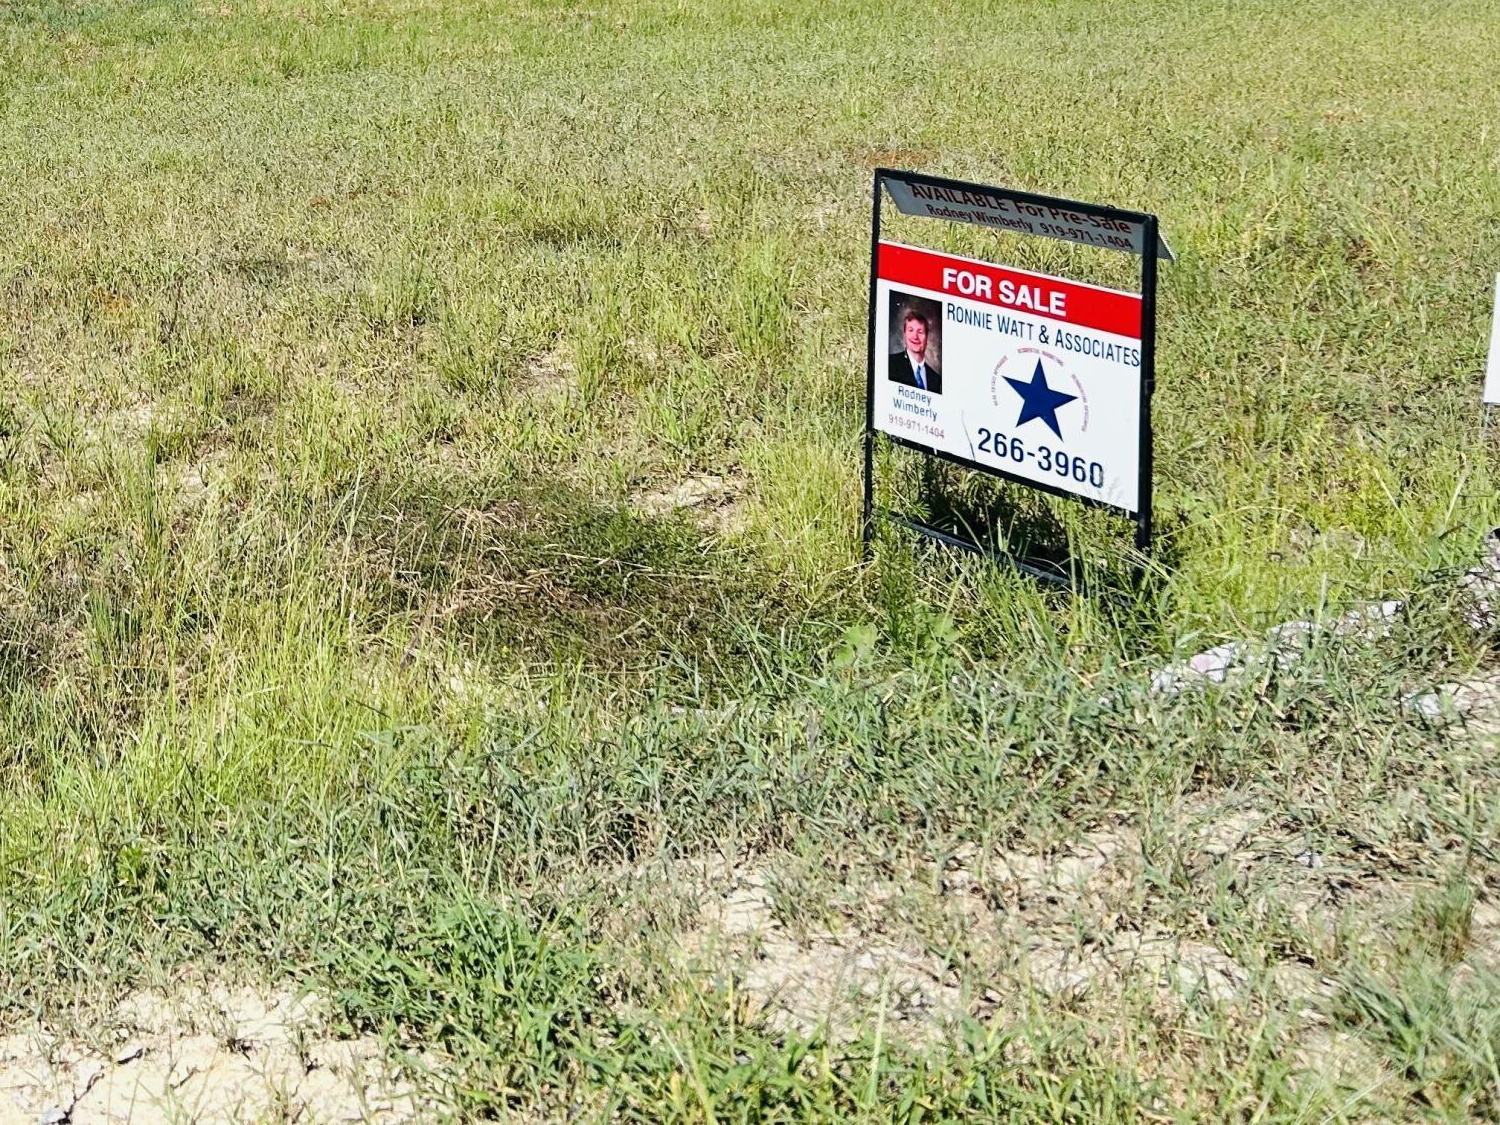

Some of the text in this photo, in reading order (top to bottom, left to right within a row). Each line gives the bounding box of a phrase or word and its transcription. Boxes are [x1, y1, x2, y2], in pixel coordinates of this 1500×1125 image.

[911, 183, 1133, 235] AVAILABLE For Pre-Sale
[925, 203, 1134, 250] Rodney Wimberly 919-971-1404
[942, 267, 1067, 317] FOR SALE
[947, 302, 993, 331] RONNIE
[997, 314, 1034, 341] WATT
[1038, 324, 1050, 344] &
[1055, 329, 1141, 368] ASSOCIATES
[892, 397, 938, 422] Wimberly
[898, 385, 932, 407] Rodney
[888, 413, 945, 439] 919-971-1404
[977, 426, 1105, 490] 266-3960
